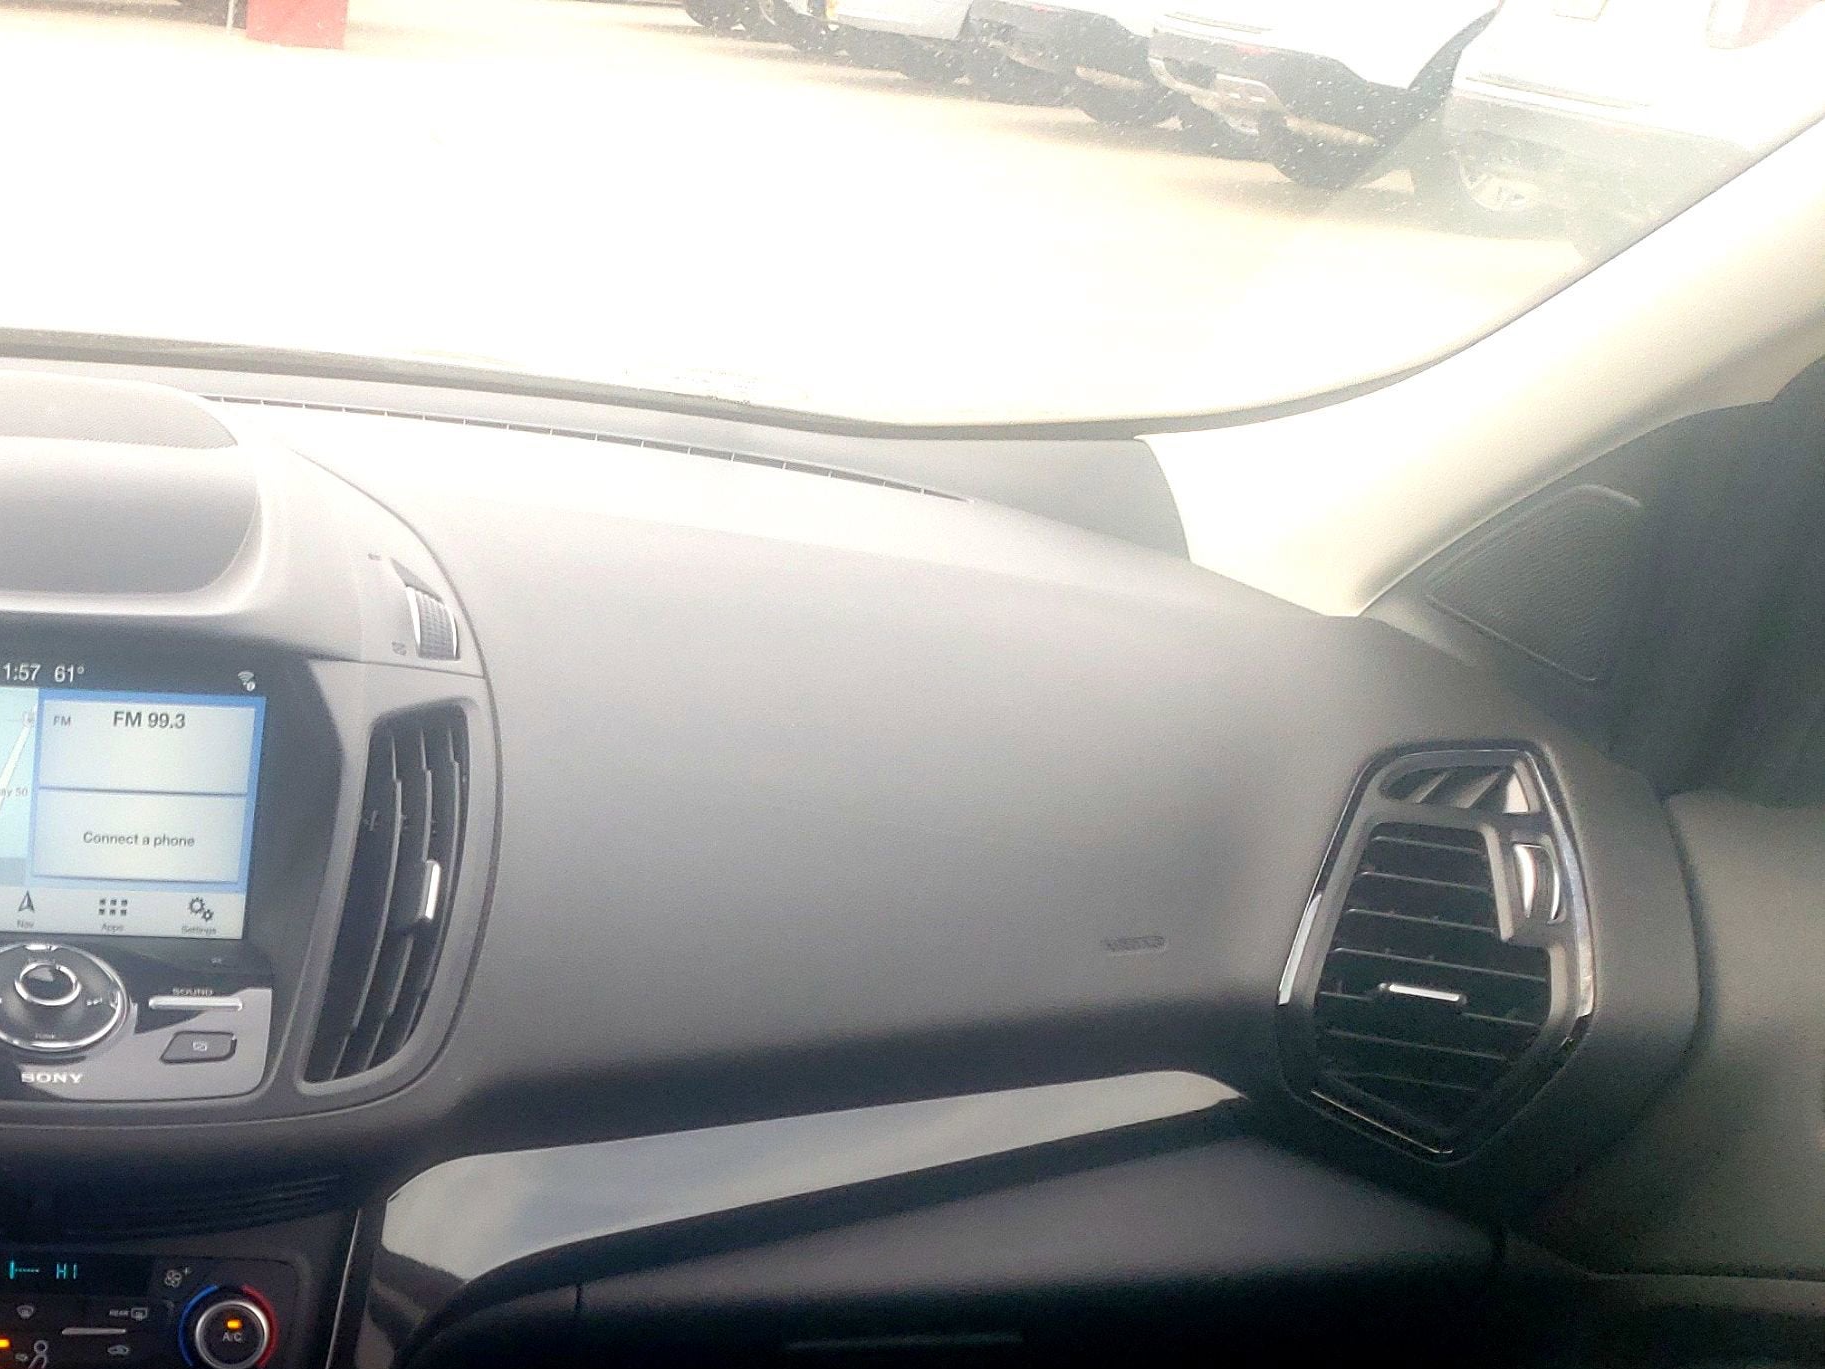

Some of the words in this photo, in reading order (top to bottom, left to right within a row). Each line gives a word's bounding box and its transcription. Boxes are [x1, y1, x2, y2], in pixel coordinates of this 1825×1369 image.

[2, 662, 42, 681] 1:57
[54, 664, 85, 683] 61°
[53, 716, 71, 727] FM
[113, 710, 142, 728] FM
[148, 712, 186, 729] 99.3
[82, 831, 139, 845] Connect
[142, 836, 150, 846] a
[153, 834, 195, 848] phone
[172, 987, 213, 996] SOUND
[21, 1072, 83, 1084] SONY
[56, 1263, 77, 1279] HI
[222, 1332, 243, 1343] A/C
